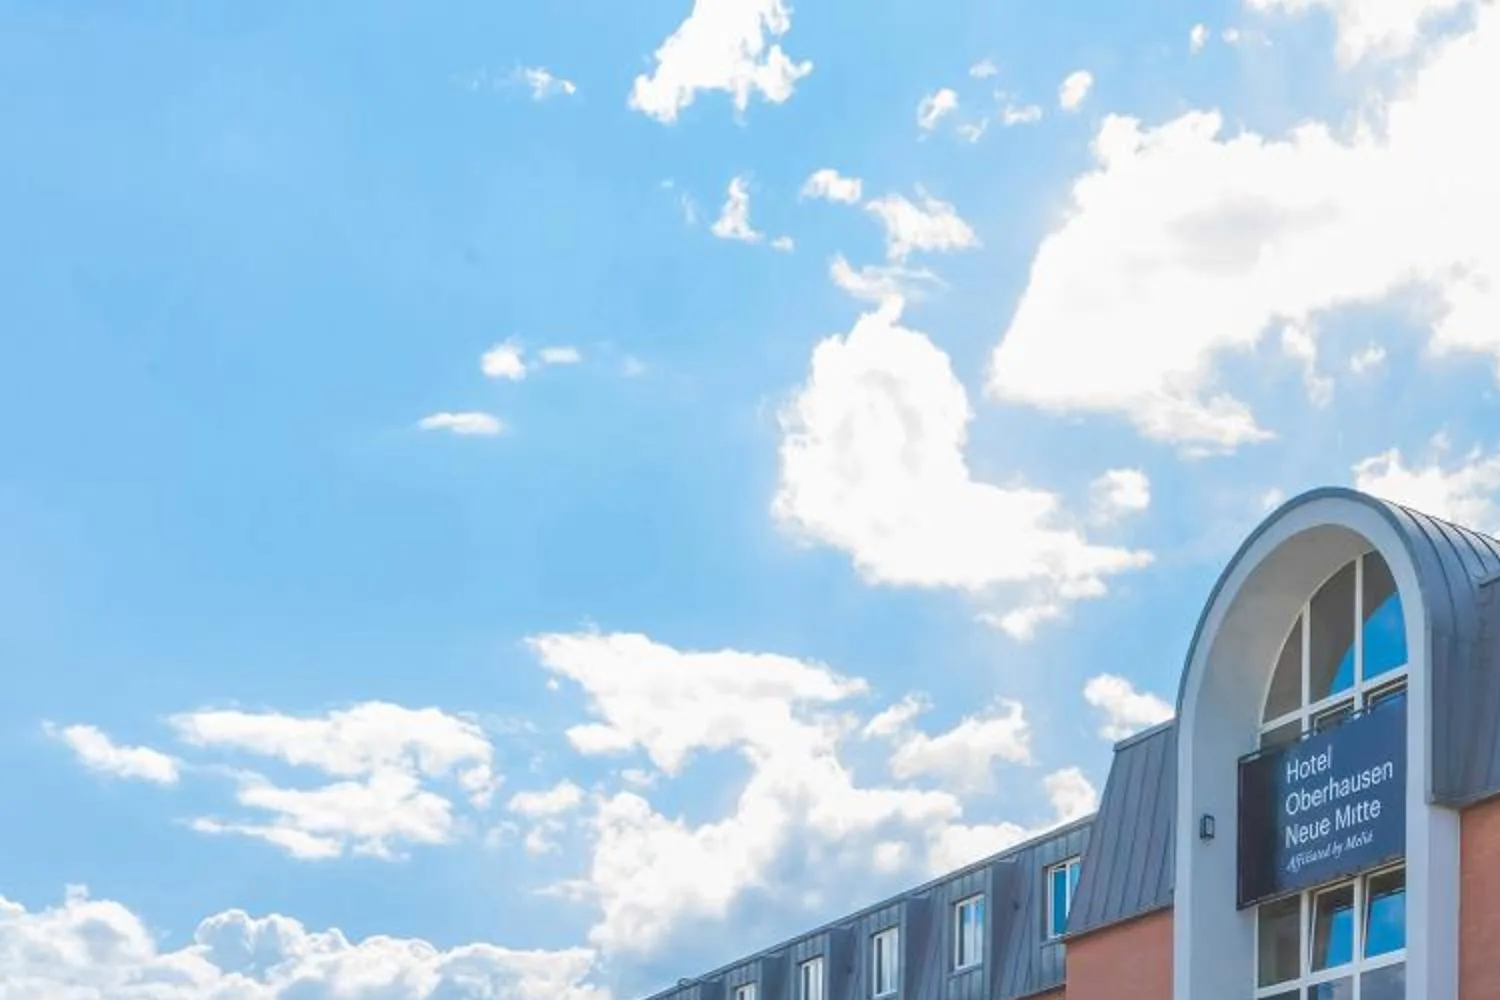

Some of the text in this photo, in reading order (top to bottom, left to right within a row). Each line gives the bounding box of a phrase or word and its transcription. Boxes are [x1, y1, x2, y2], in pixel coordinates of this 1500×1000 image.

[1285, 761, 1393, 815] Oberhausen
[1286, 744, 1332, 784] Hotel
[1285, 799, 1381, 849] Neue Mitte
